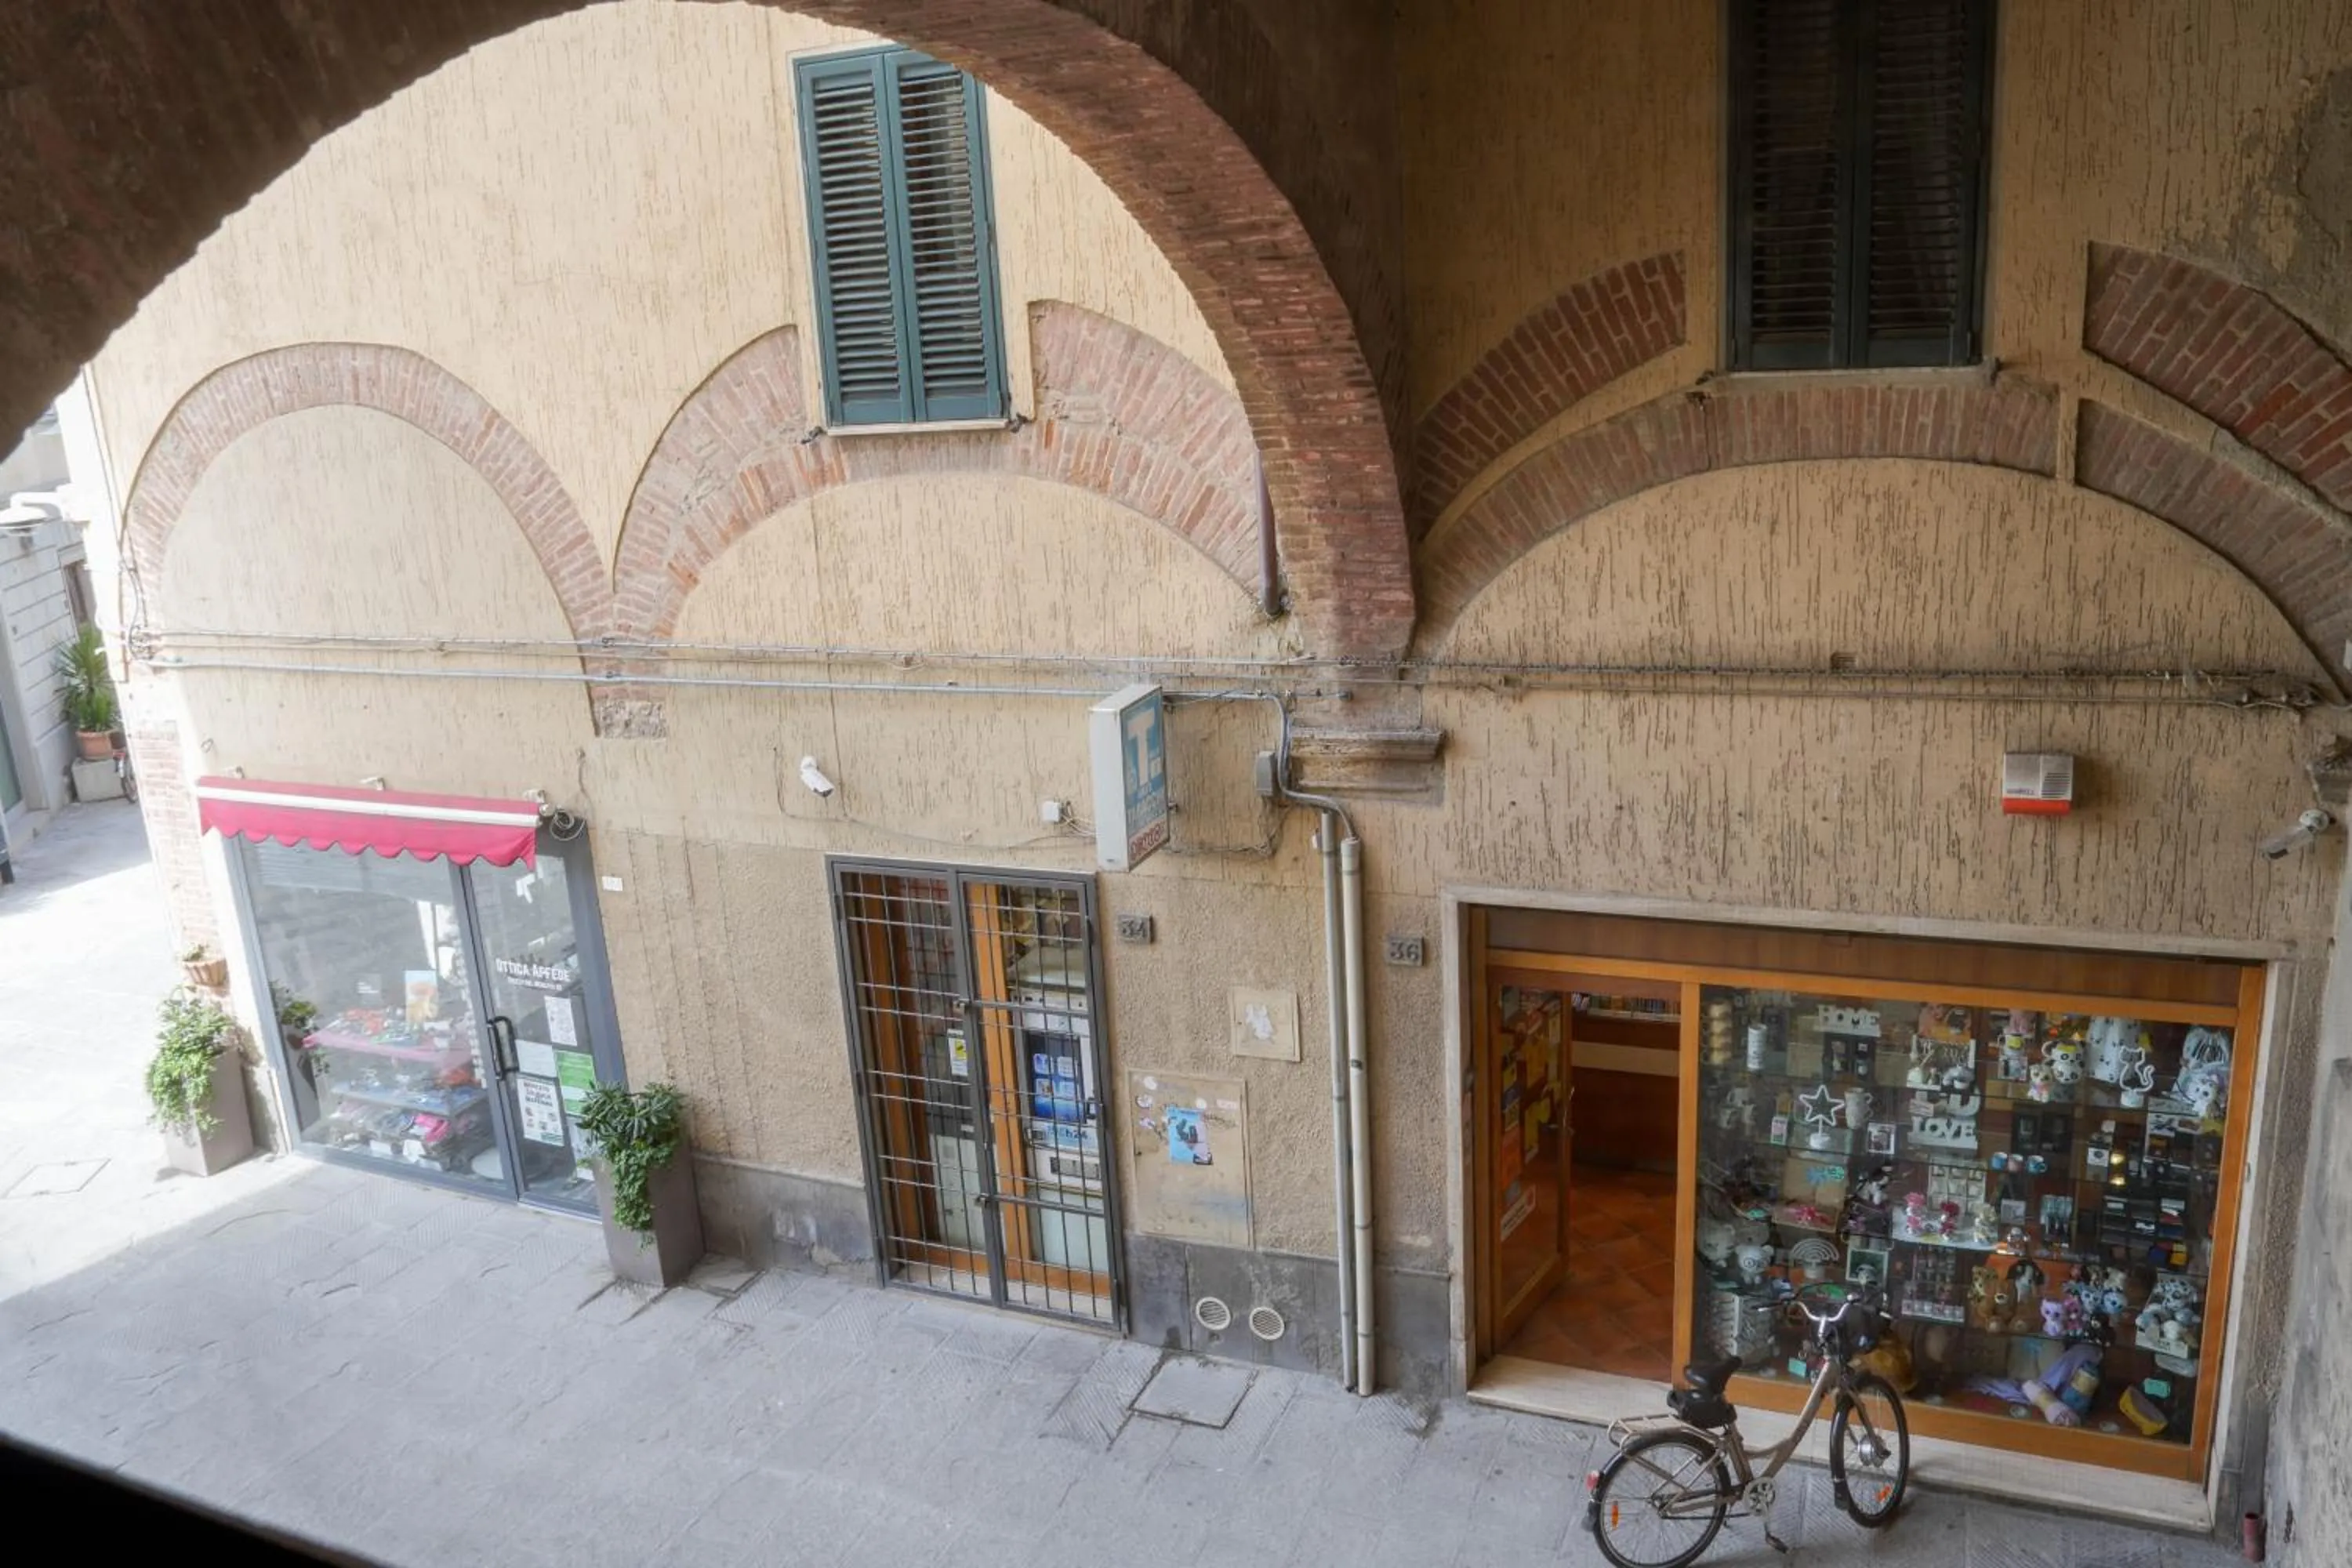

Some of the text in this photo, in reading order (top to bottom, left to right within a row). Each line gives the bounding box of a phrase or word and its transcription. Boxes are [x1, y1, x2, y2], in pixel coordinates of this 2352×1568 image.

[1127, 707, 1156, 786] T
[1121, 920, 1145, 938] 34
[1390, 941, 1419, 961] 36
[495, 957, 531, 976] OTTICA
[1911, 1116, 1976, 1142] LOVE
